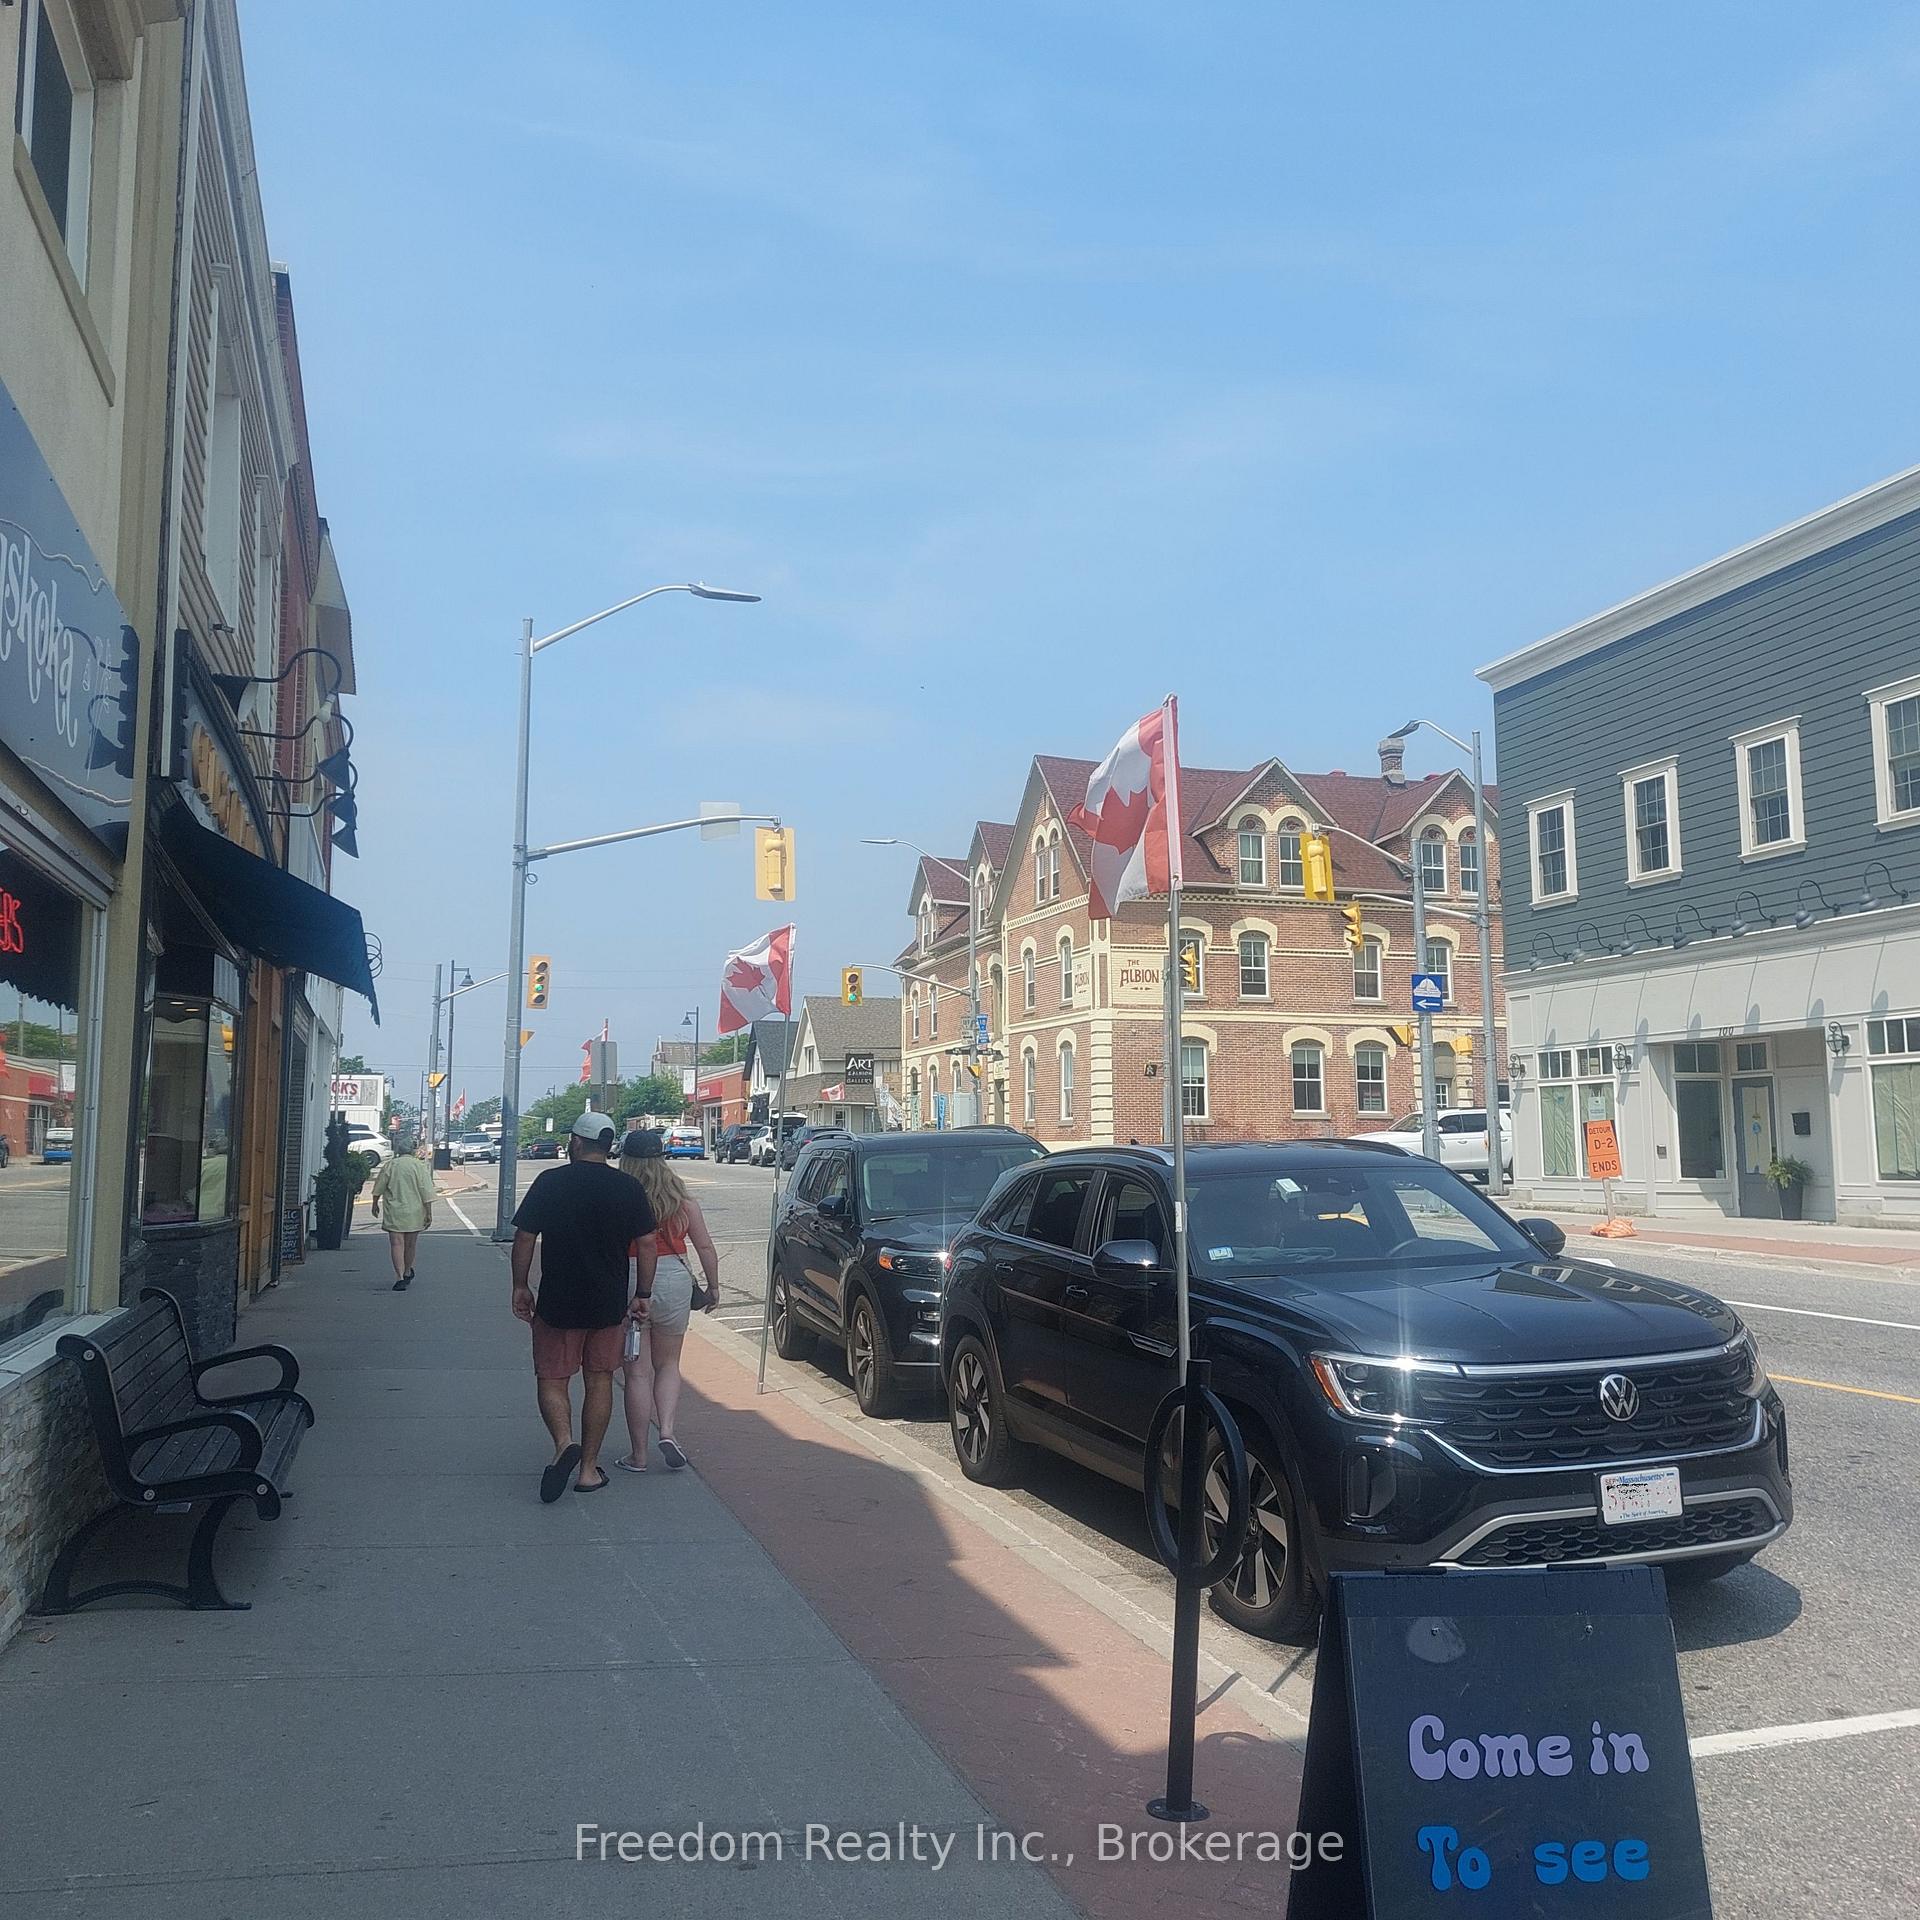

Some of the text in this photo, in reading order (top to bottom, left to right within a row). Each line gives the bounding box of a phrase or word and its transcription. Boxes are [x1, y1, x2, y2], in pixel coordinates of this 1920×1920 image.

[1120, 969, 1160, 987] ALBION
[1719, 1027, 1733, 1037] 100
[847, 1057, 874, 1070] ART
[1589, 1126, 1611, 1135] DETOUR
[1594, 1137, 1614, 1149] D-2
[1592, 1160, 1618, 1172] ENDS
[1618, 1472, 1665, 1484] Massachusetts
[1409, 1714, 1650, 1781] Come in
[1417, 1825, 1650, 1891] To see
